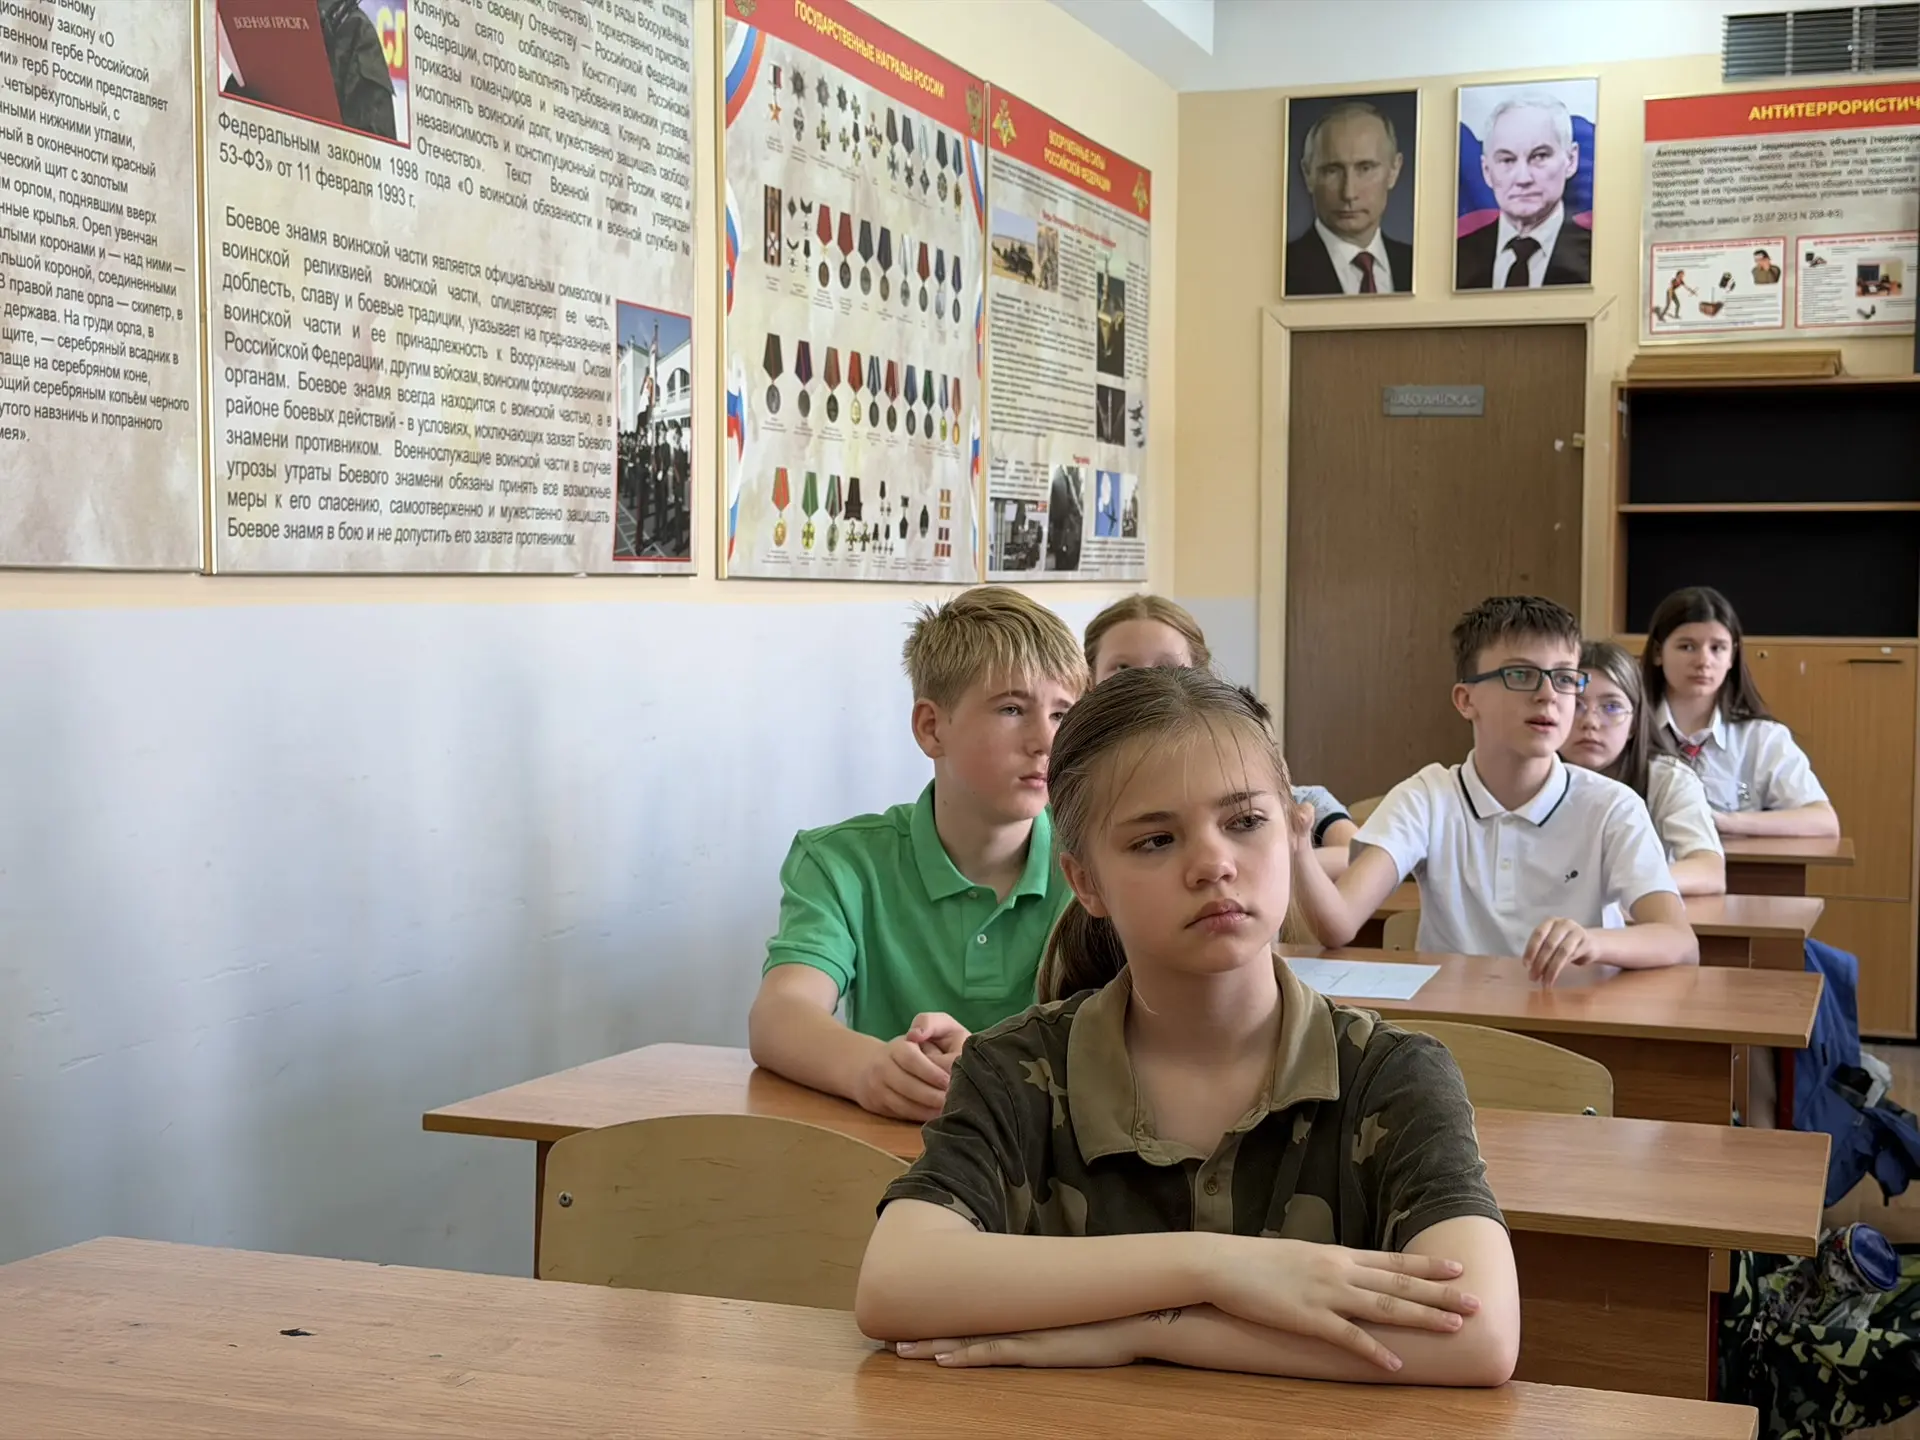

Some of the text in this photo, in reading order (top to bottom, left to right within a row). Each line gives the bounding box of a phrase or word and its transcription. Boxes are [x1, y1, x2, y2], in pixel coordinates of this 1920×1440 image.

[57, 18, 95, 45] закону
[98, 31, 114, 47] «О
[794, 0, 874, 63] ГОСУДАРСТВЕННЫЕ
[51, 41, 83, 62] гербе
[86, 48, 148, 82] Российской
[414, 54, 461, 84] приказы
[22, 56, 48, 76] герб
[52, 61, 92, 89] России
[96, 78, 168, 111] представляет
[415, 83, 473, 114] исполнять
[39, 111, 91, 136] нижними
[113, 108, 119, 120] с
[26, 132, 33, 145] в
[36, 135, 108, 165] оконечности
[111, 154, 155, 177] красный
[218, 110, 319, 155] Федеральным
[327, 143, 381, 171] законом
[390, 156, 418, 180] 1998
[425, 170, 450, 191] года
[44, 161, 68, 179] щит
[71, 168, 78, 181] с
[80, 170, 127, 193] золотым
[219, 141, 272, 171] 53-ФЗ»
[277, 160, 292, 177] от
[297, 161, 310, 182] 11
[315, 166, 372, 197] февраля
[377, 181, 405, 205] 1993
[59, 189, 123, 216] поднявшим
[126, 205, 156, 225] вверх
[82, 215, 111, 237] Орел
[114, 226, 157, 246] увенчан
[225, 205, 279, 236] Боевое
[285, 223, 326, 245] знамя
[332, 232, 389, 258] воинской
[394, 246, 427, 266] части
[40, 234, 95, 257] коронами
[98, 246, 105, 259] и
[123, 252, 143, 270] над
[145, 256, 171, 273] ними
[222, 241, 289, 268] воинской
[303, 256, 372, 283] реликвией
[384, 272, 436, 296] воинской
[9, 278, 52, 297] правой
[55, 286, 83, 302] лапе
[86, 291, 113, 309] орла
[176, 308, 182, 320] в
[98, 270, 176, 296] соединенными
[222, 271, 294, 302] доблесть,
[300, 286, 339, 311] славу
[344, 293, 352, 308] и
[357, 291, 403, 318] боевые
[63, 308, 79, 326] На
[83, 314, 113, 334] груди
[148, 326, 154, 338] в
[223, 303, 291, 329] воинской
[303, 316, 340, 336] части
[352, 324, 360, 339] и
[370, 327, 385, 343] ее
[396, 331, 488, 359] принадлежность
[33, 356, 48, 369] на
[51, 358, 120, 379] серебряном
[57, 335, 126, 356] серебряный
[128, 345, 170, 363] всадник
[172, 352, 178, 364] в
[224, 329, 308, 361] Российской
[311, 343, 386, 374] Федерации,
[389, 359, 430, 379] другим
[33, 380, 105, 400] серебряным
[109, 390, 147, 406] копьём
[149, 395, 189, 412] черного
[224, 364, 289, 388] органам.
[298, 370, 346, 395] Боевое
[353, 382, 390, 400] знамя
[397, 387, 435, 408] всегда
[34, 405, 88, 422] навзничь
[91, 411, 98, 424] и
[101, 411, 162, 430] попранного
[225, 394, 279, 418] районе
[283, 398, 334, 423] боевых
[337, 407, 395, 429] действий
[407, 416, 414, 431] в
[226, 428, 491, 466] знамени противником. Военнослужащие
[226, 460, 276, 481] угрозы
[284, 463, 331, 484] утраты
[338, 463, 388, 485] Боевого
[394, 471, 443, 488] знамени
[227, 490, 266, 511] меры
[275, 493, 282, 508] к
[289, 494, 310, 509] его
[318, 495, 381, 515] спасению,
[389, 499, 483, 519] самоотверженно
[227, 516, 279, 538] Боевое
[283, 523, 323, 539] знамя
[327, 525, 334, 540] в
[338, 520, 363, 540] бою
[366, 527, 374, 540] и
[377, 527, 392, 541] не
[393, 527, 451, 546] допустить
